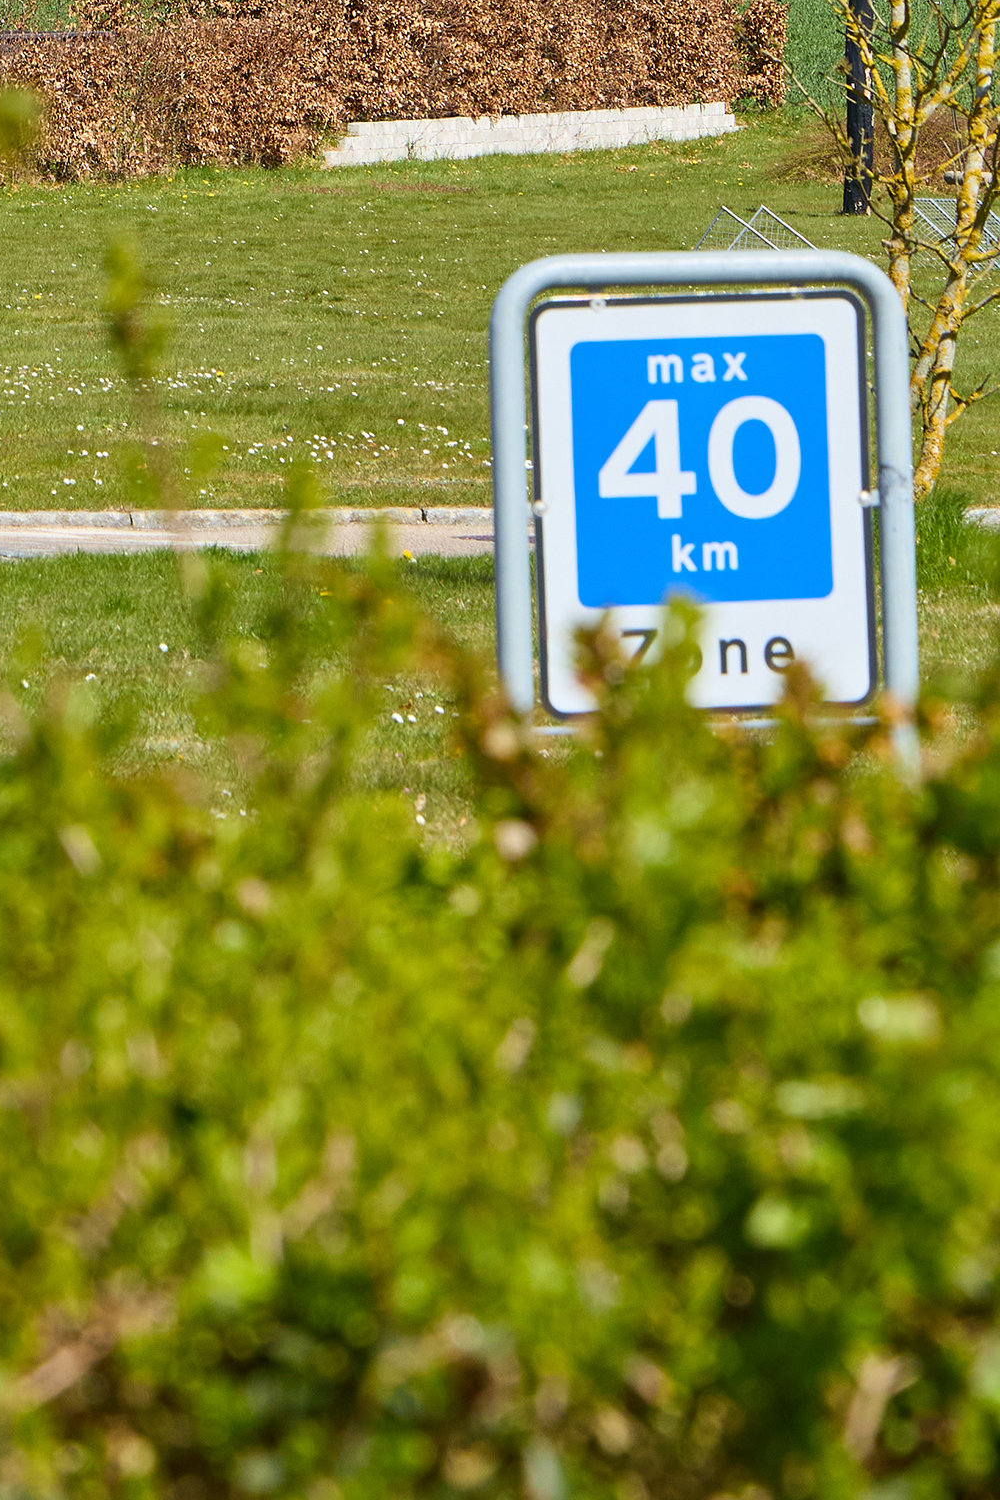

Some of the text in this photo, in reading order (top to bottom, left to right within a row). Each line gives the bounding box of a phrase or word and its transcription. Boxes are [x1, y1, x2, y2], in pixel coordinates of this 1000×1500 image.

[647, 352, 748, 384] max
[598, 395, 801, 520] 40
[671, 534, 739, 572] km
